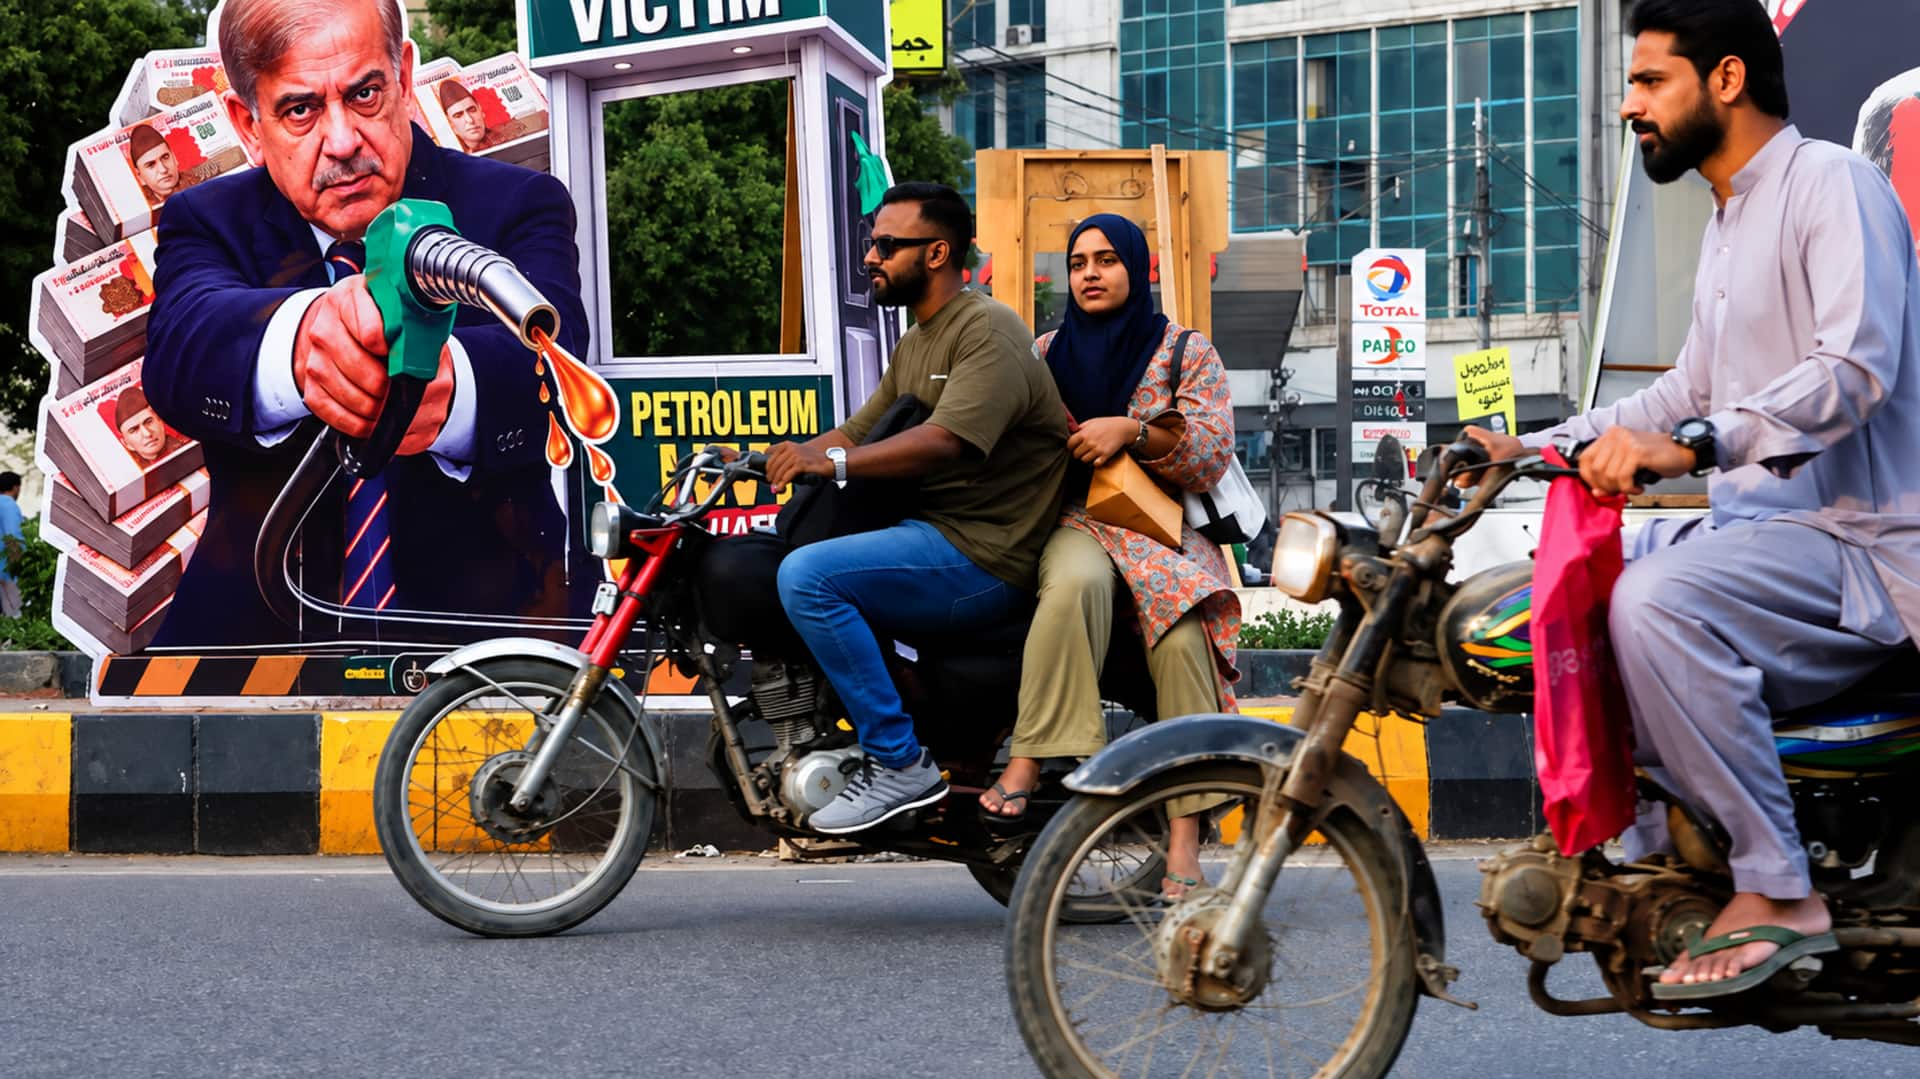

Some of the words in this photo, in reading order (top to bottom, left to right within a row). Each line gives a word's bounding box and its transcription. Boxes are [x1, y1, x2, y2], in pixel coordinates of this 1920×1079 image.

[569, 0, 779, 43] VICIM
[1360, 304, 1420, 317] TOTAL
[1362, 339, 1416, 353] PARCO
[631, 389, 818, 437] PETROLEUM
